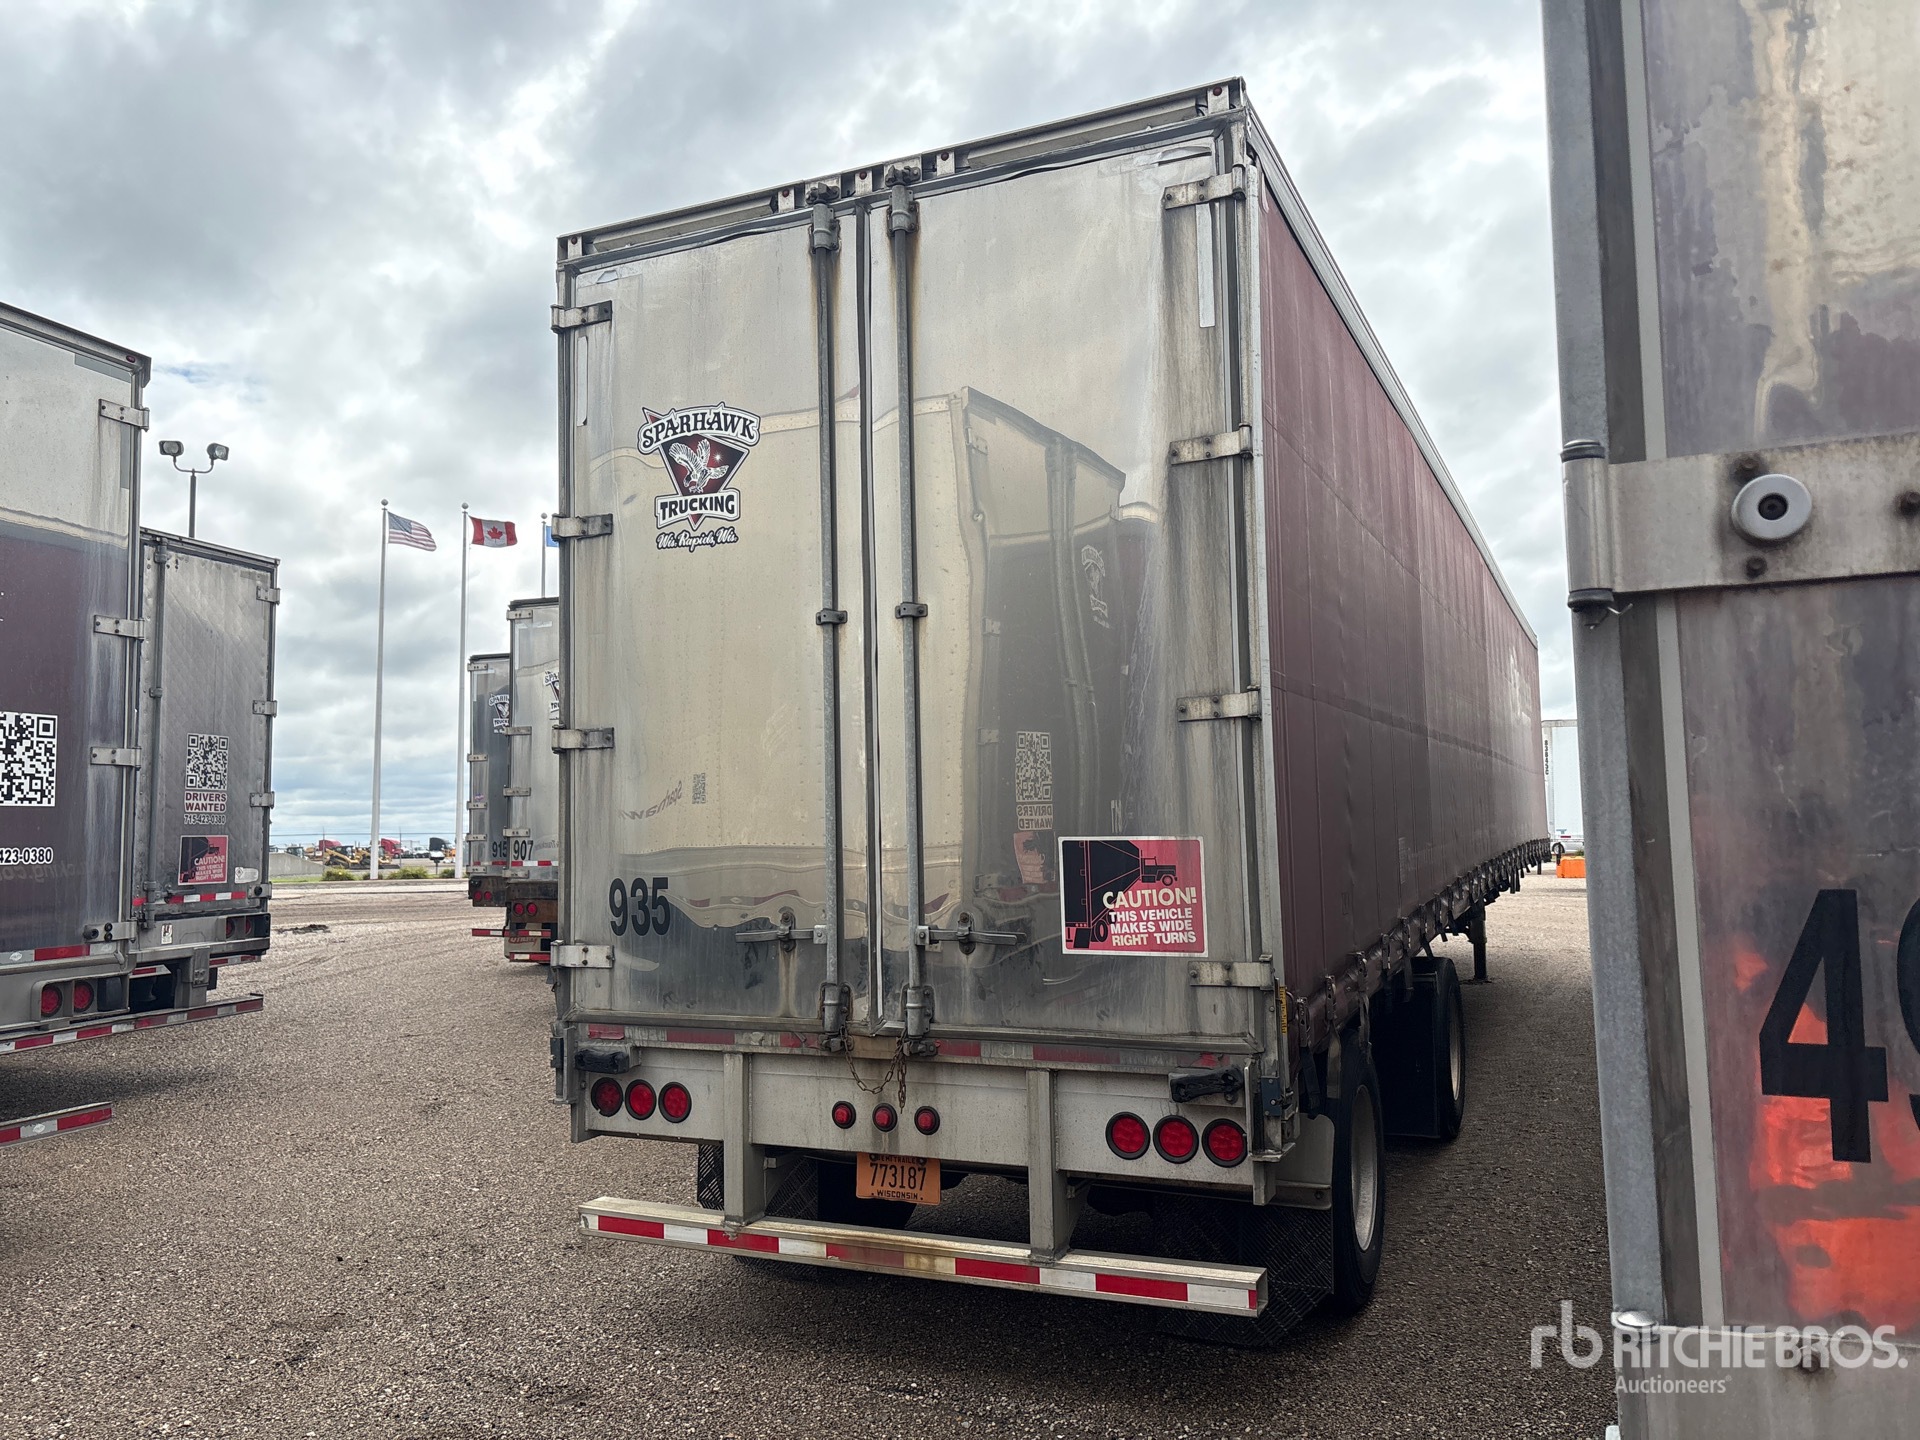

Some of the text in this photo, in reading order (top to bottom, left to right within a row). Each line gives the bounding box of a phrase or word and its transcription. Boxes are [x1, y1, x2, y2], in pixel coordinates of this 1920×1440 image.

[642, 411, 755, 448] SPARHAWK
[660, 494, 735, 521] TRUCKING
[657, 533, 677, 549] Wis.
[716, 527, 738, 544] Wis.
[185, 792, 227, 802] DRIVERS
[185, 802, 226, 812] WANTED
[492, 841, 508, 858] 915
[513, 840, 534, 860] 907
[609, 877, 671, 936] 935
[1102, 887, 1197, 909] CAUTION!
[1109, 908, 1193, 922] THIS VEHICLE
[1110, 920, 1193, 934] MAKES WIDE
[1112, 931, 1197, 946] RIGHT TURNS
[1759, 889, 1920, 1163] 4
[870, 1163, 926, 1191] 773187
[877, 1189, 918, 1200] WISCONSIN
